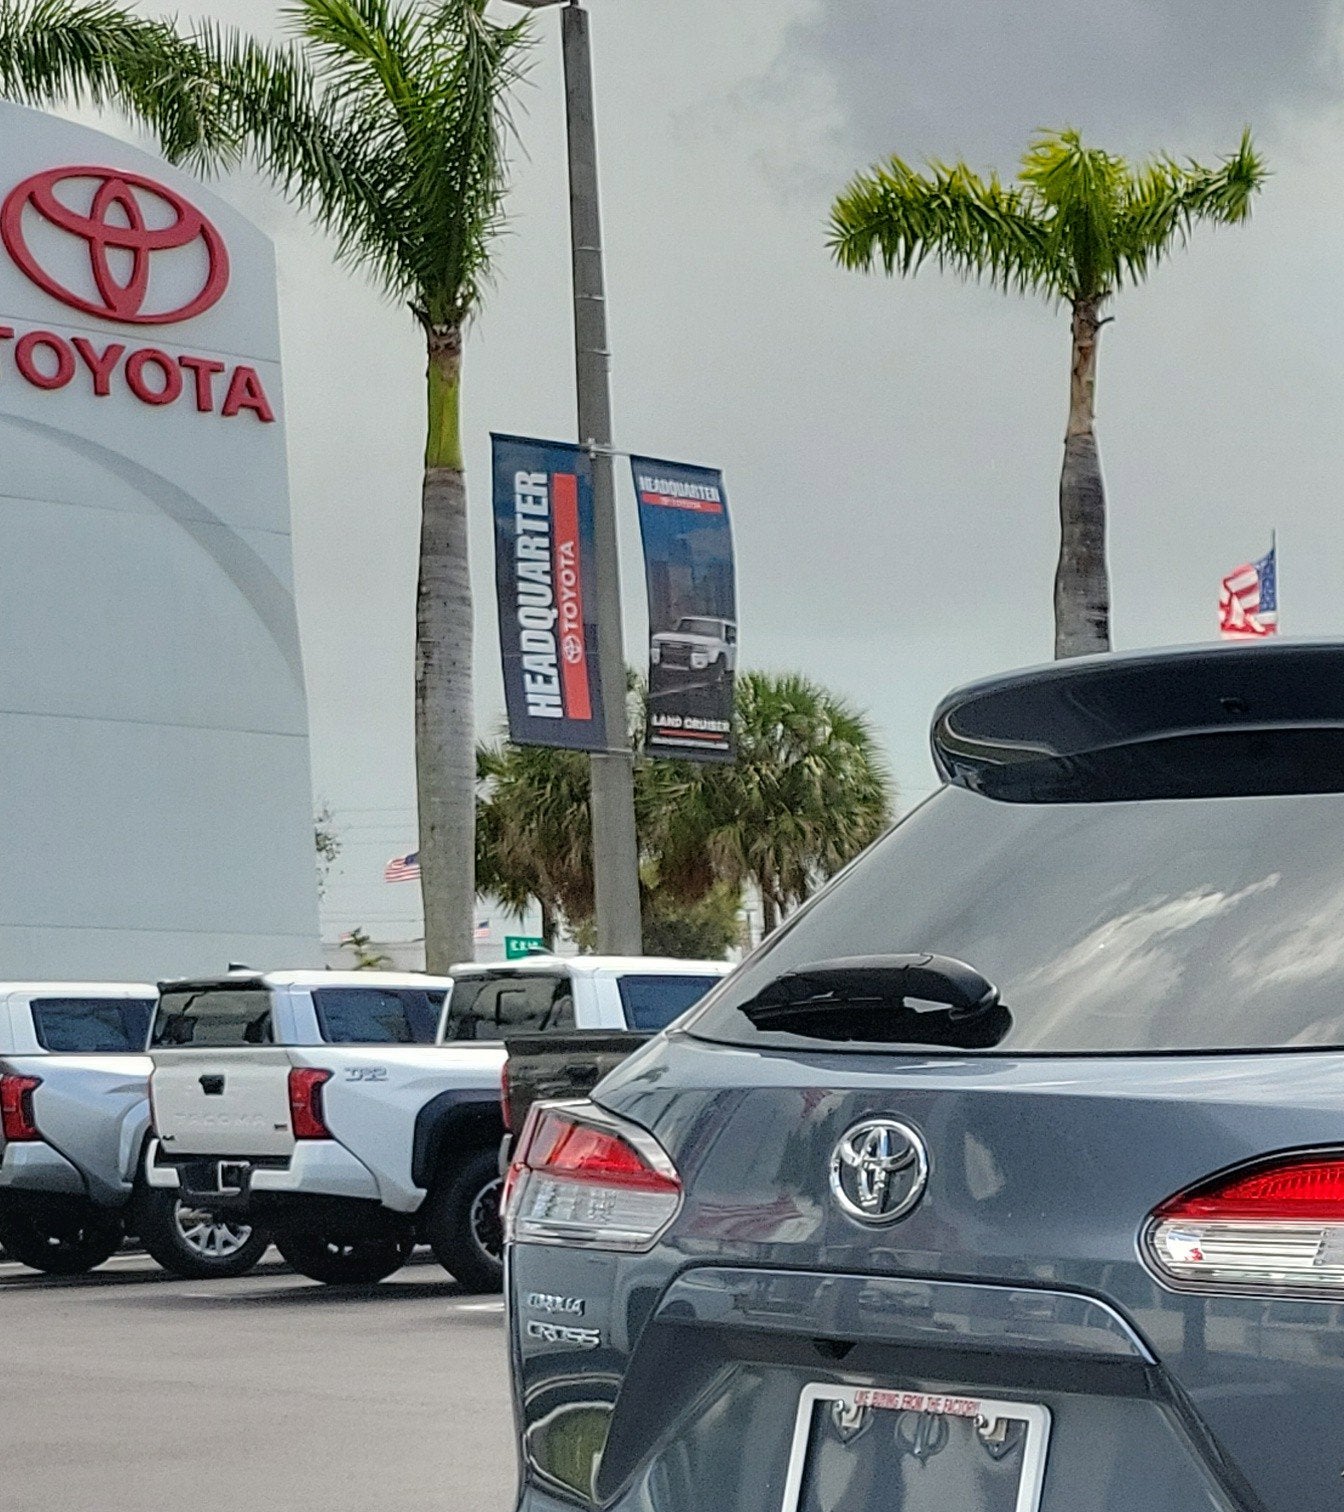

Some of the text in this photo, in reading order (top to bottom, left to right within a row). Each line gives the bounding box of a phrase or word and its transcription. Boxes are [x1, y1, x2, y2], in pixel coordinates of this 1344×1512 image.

[0, 326, 275, 422] OYOTA
[515, 470, 563, 718] HEADQUARTER
[559, 540, 582, 631] TOYOTA
[527, 1320, 601, 1350] CROSS
